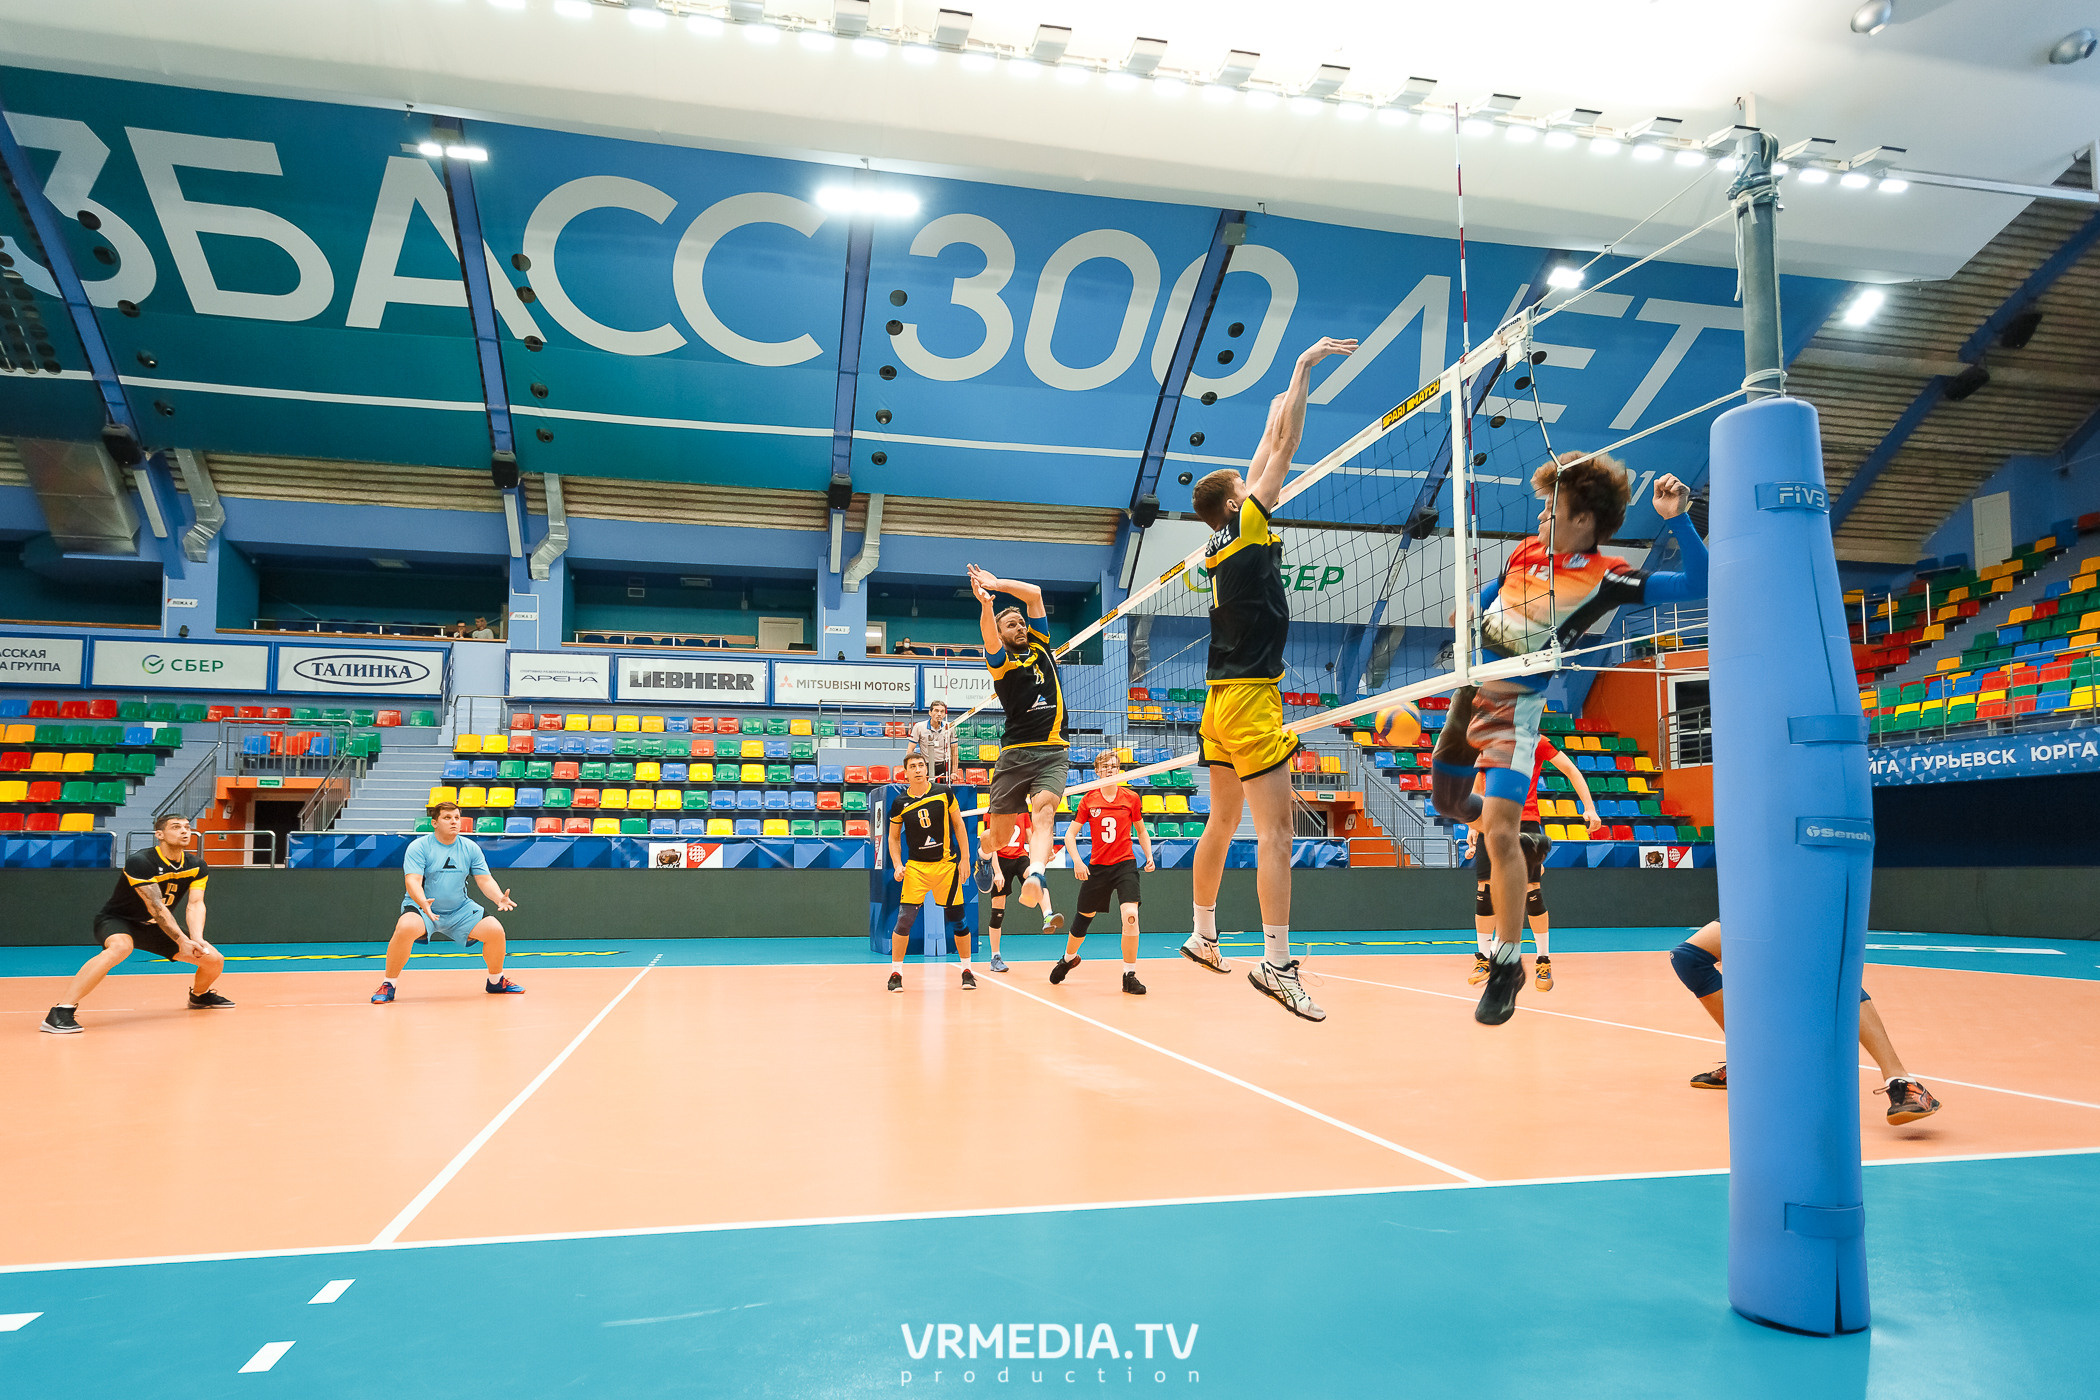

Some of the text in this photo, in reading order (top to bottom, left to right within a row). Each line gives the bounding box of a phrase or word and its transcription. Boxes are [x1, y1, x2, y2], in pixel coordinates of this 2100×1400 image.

[889, 213, 1299, 400] 300
[1308, 274, 1746, 431] ЛЕТ
[1279, 564, 1345, 591] БЕР
[10, 661, 61, 672] ГРУППА
[171, 658, 224, 672] СБЕР
[311, 662, 413, 679] ТАЛИНКА
[520, 674, 599, 683] АРЕНА
[629, 670, 755, 691] LIEBHERR
[796, 678, 911, 692] MITSUBISHI MOTORS
[1910, 748, 2017, 771] ГУРЬЕВСК
[2030, 741, 2099, 762] ЮРГА
[917, 808, 932, 829] 8
[1101, 816, 1117, 844] 3
[162, 882, 178, 907] 5
